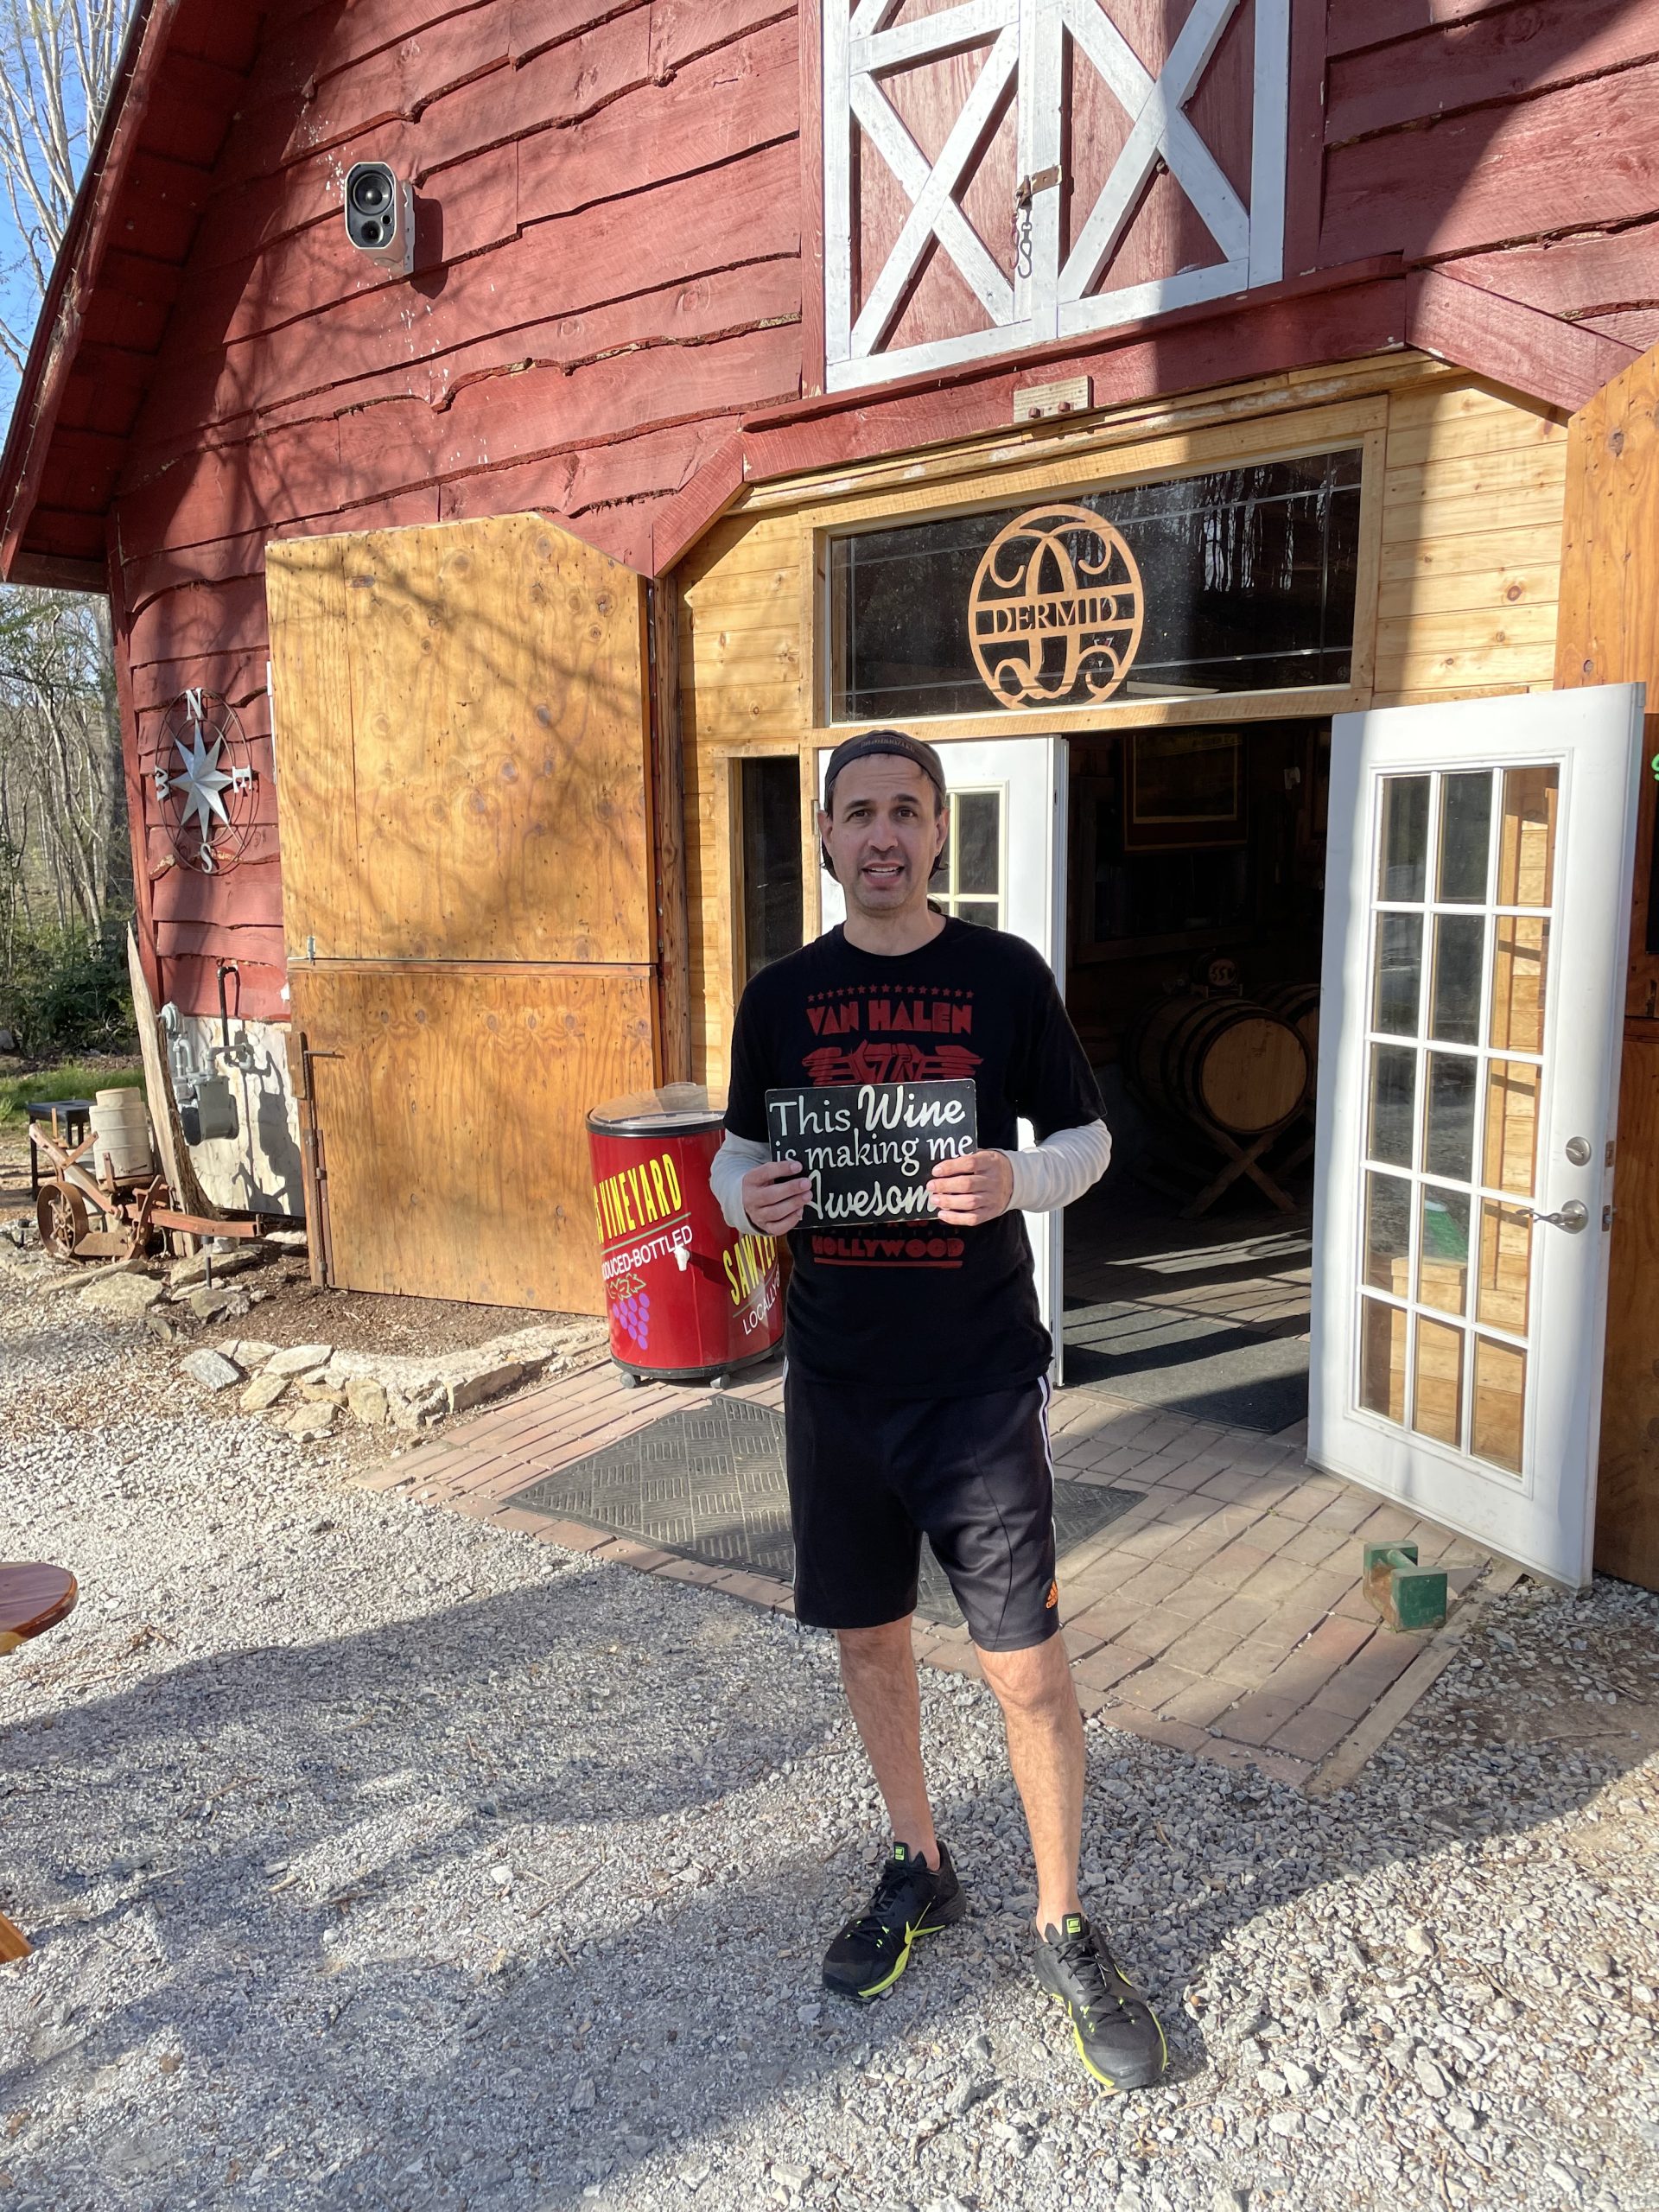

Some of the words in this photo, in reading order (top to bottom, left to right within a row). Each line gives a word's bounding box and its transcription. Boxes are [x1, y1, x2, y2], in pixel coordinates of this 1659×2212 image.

[993, 595, 1117, 633] DERMID
[186, 689, 203, 721] N
[232, 765, 251, 794] E
[200, 842, 213, 874] S
[807, 1001, 859, 1035] VAN
[868, 1000, 973, 1035] HALEN
[770, 1095, 851, 1136] This
[858, 1085, 965, 1131] Wine
[776, 1141, 797, 1162] is
[804, 1128, 919, 1176] making
[926, 1135, 974, 1160] me
[599, 1154, 682, 1239] VINEYARD
[804, 1169, 940, 1219] Awesom
[811, 1235, 965, 1258] HOLLYWOOD
[743, 1283, 778, 1336] LOCALLY
